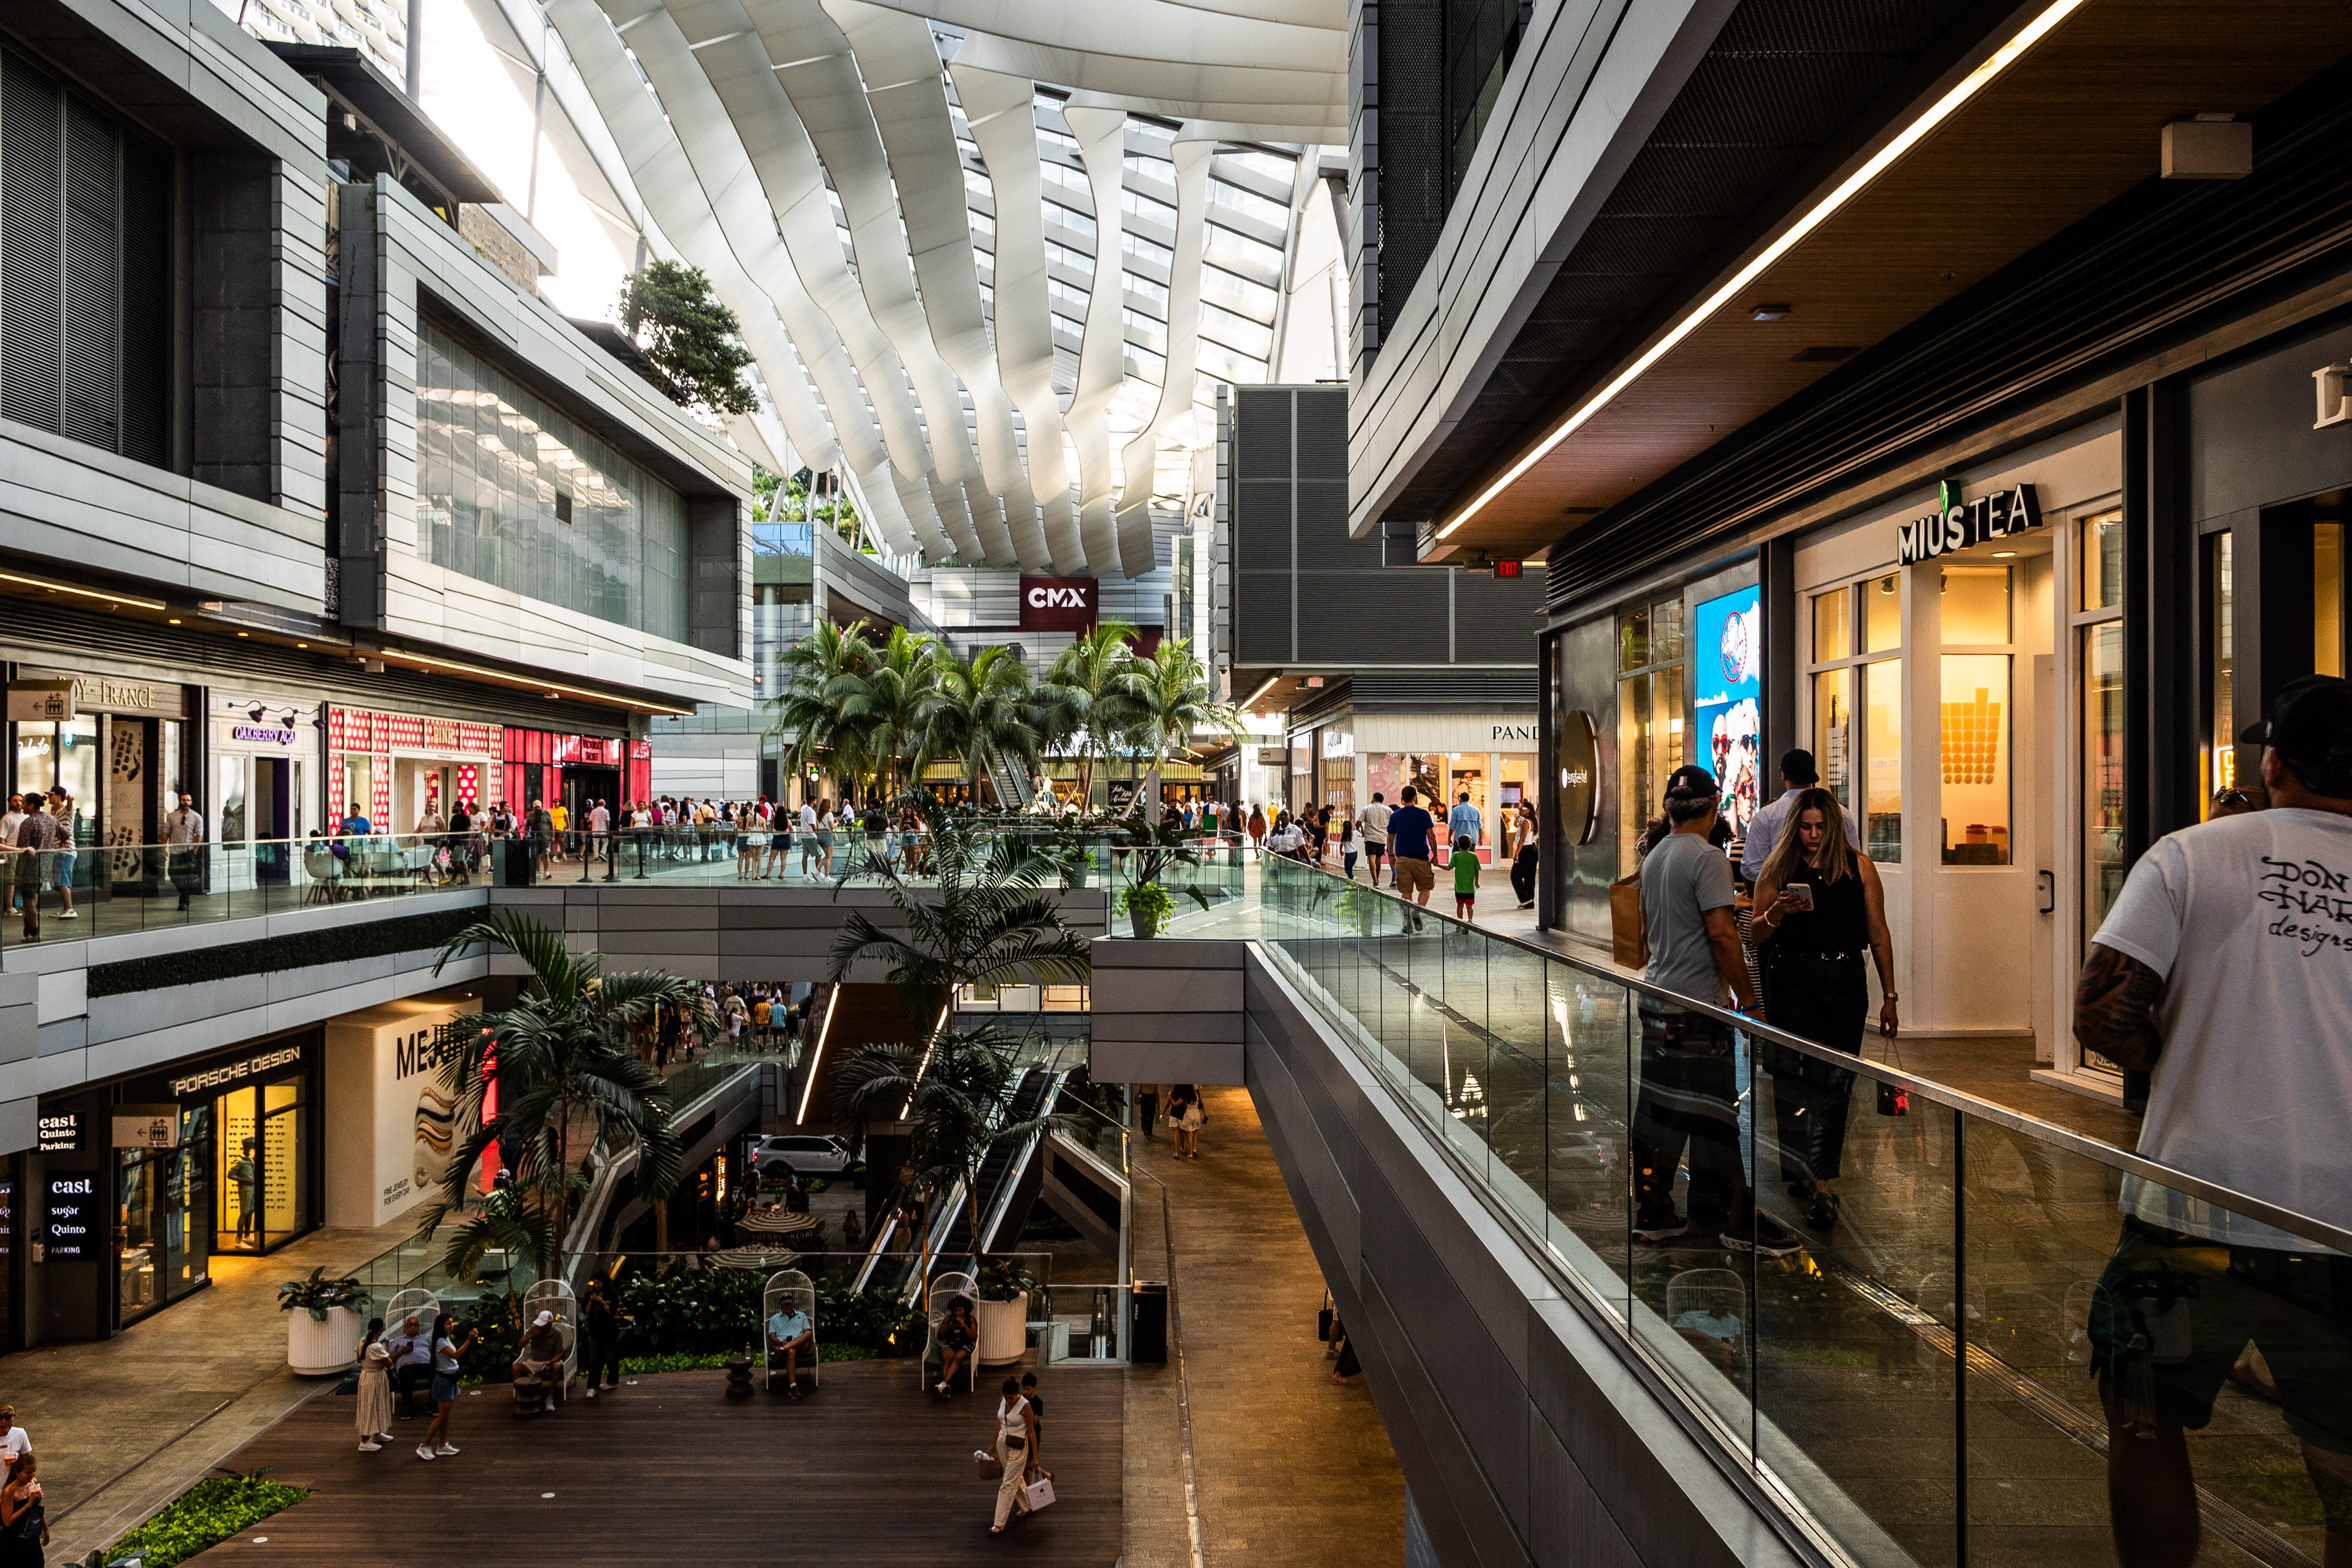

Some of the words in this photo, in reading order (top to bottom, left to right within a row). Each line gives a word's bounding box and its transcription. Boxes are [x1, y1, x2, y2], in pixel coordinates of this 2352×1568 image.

[1969, 483, 2030, 542] TEA
[1500, 561, 1517, 576] EXIT
[1028, 587, 1086, 608] CMX
[101, 681, 154, 708] FRANCE
[235, 726, 278, 742] OAKBERRY
[433, 726, 454, 744] PINK
[2259, 855, 2350, 893] DON
[2268, 915, 2352, 957] designs
[175, 1061, 247, 1096] PORSCHE
[252, 1046, 300, 1073] DESIGN
[39, 1114, 77, 1129] east
[40, 1129, 76, 1139] Quinto
[40, 1142, 76, 1151] Parking
[52, 1179, 93, 1194] east
[384, 1186, 392, 1196] FINE
[392, 1178, 408, 1192] JEWELRY
[392, 1190, 403, 1203] EVERY
[51, 1205, 79, 1218] sugar
[51, 1224, 86, 1236] Quinto
[790, 1230, 813, 1239] HENRY
